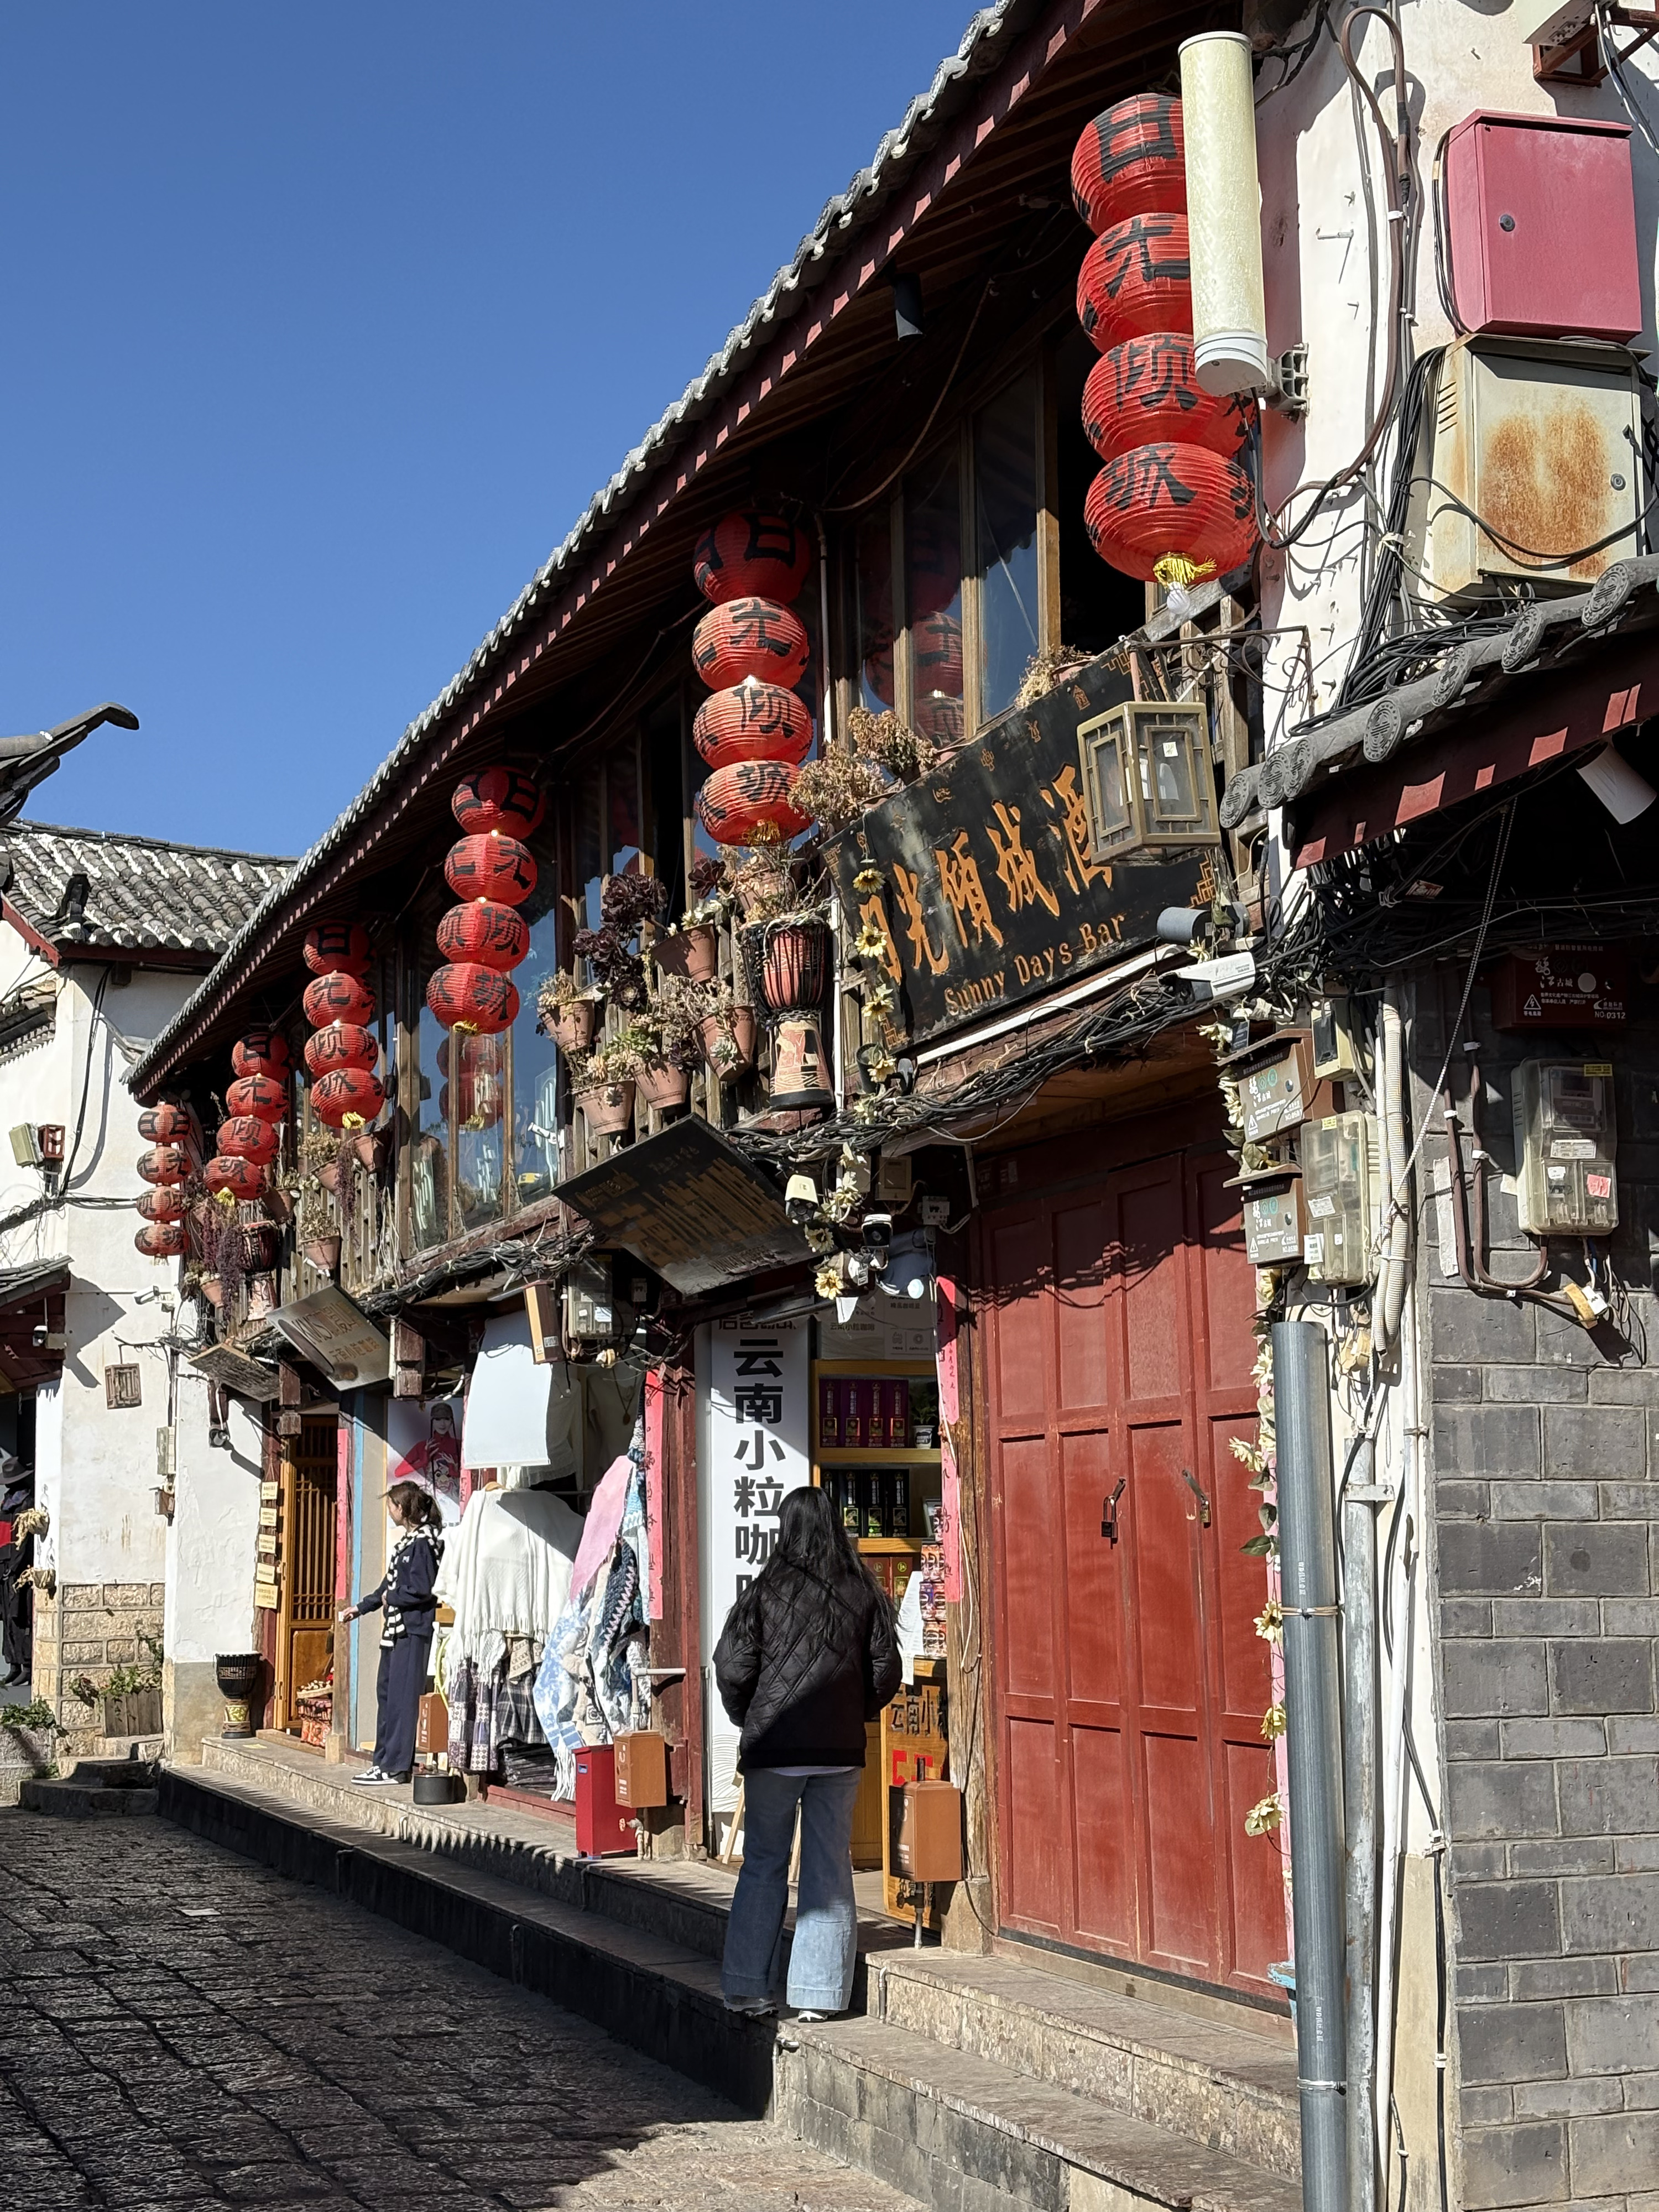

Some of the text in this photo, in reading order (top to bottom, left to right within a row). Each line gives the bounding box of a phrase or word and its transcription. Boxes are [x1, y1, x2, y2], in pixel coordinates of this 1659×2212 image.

[943, 915, 1125, 1016] Sunny Days Bar
[733, 1338, 786, 1598] 云南小粒咖
